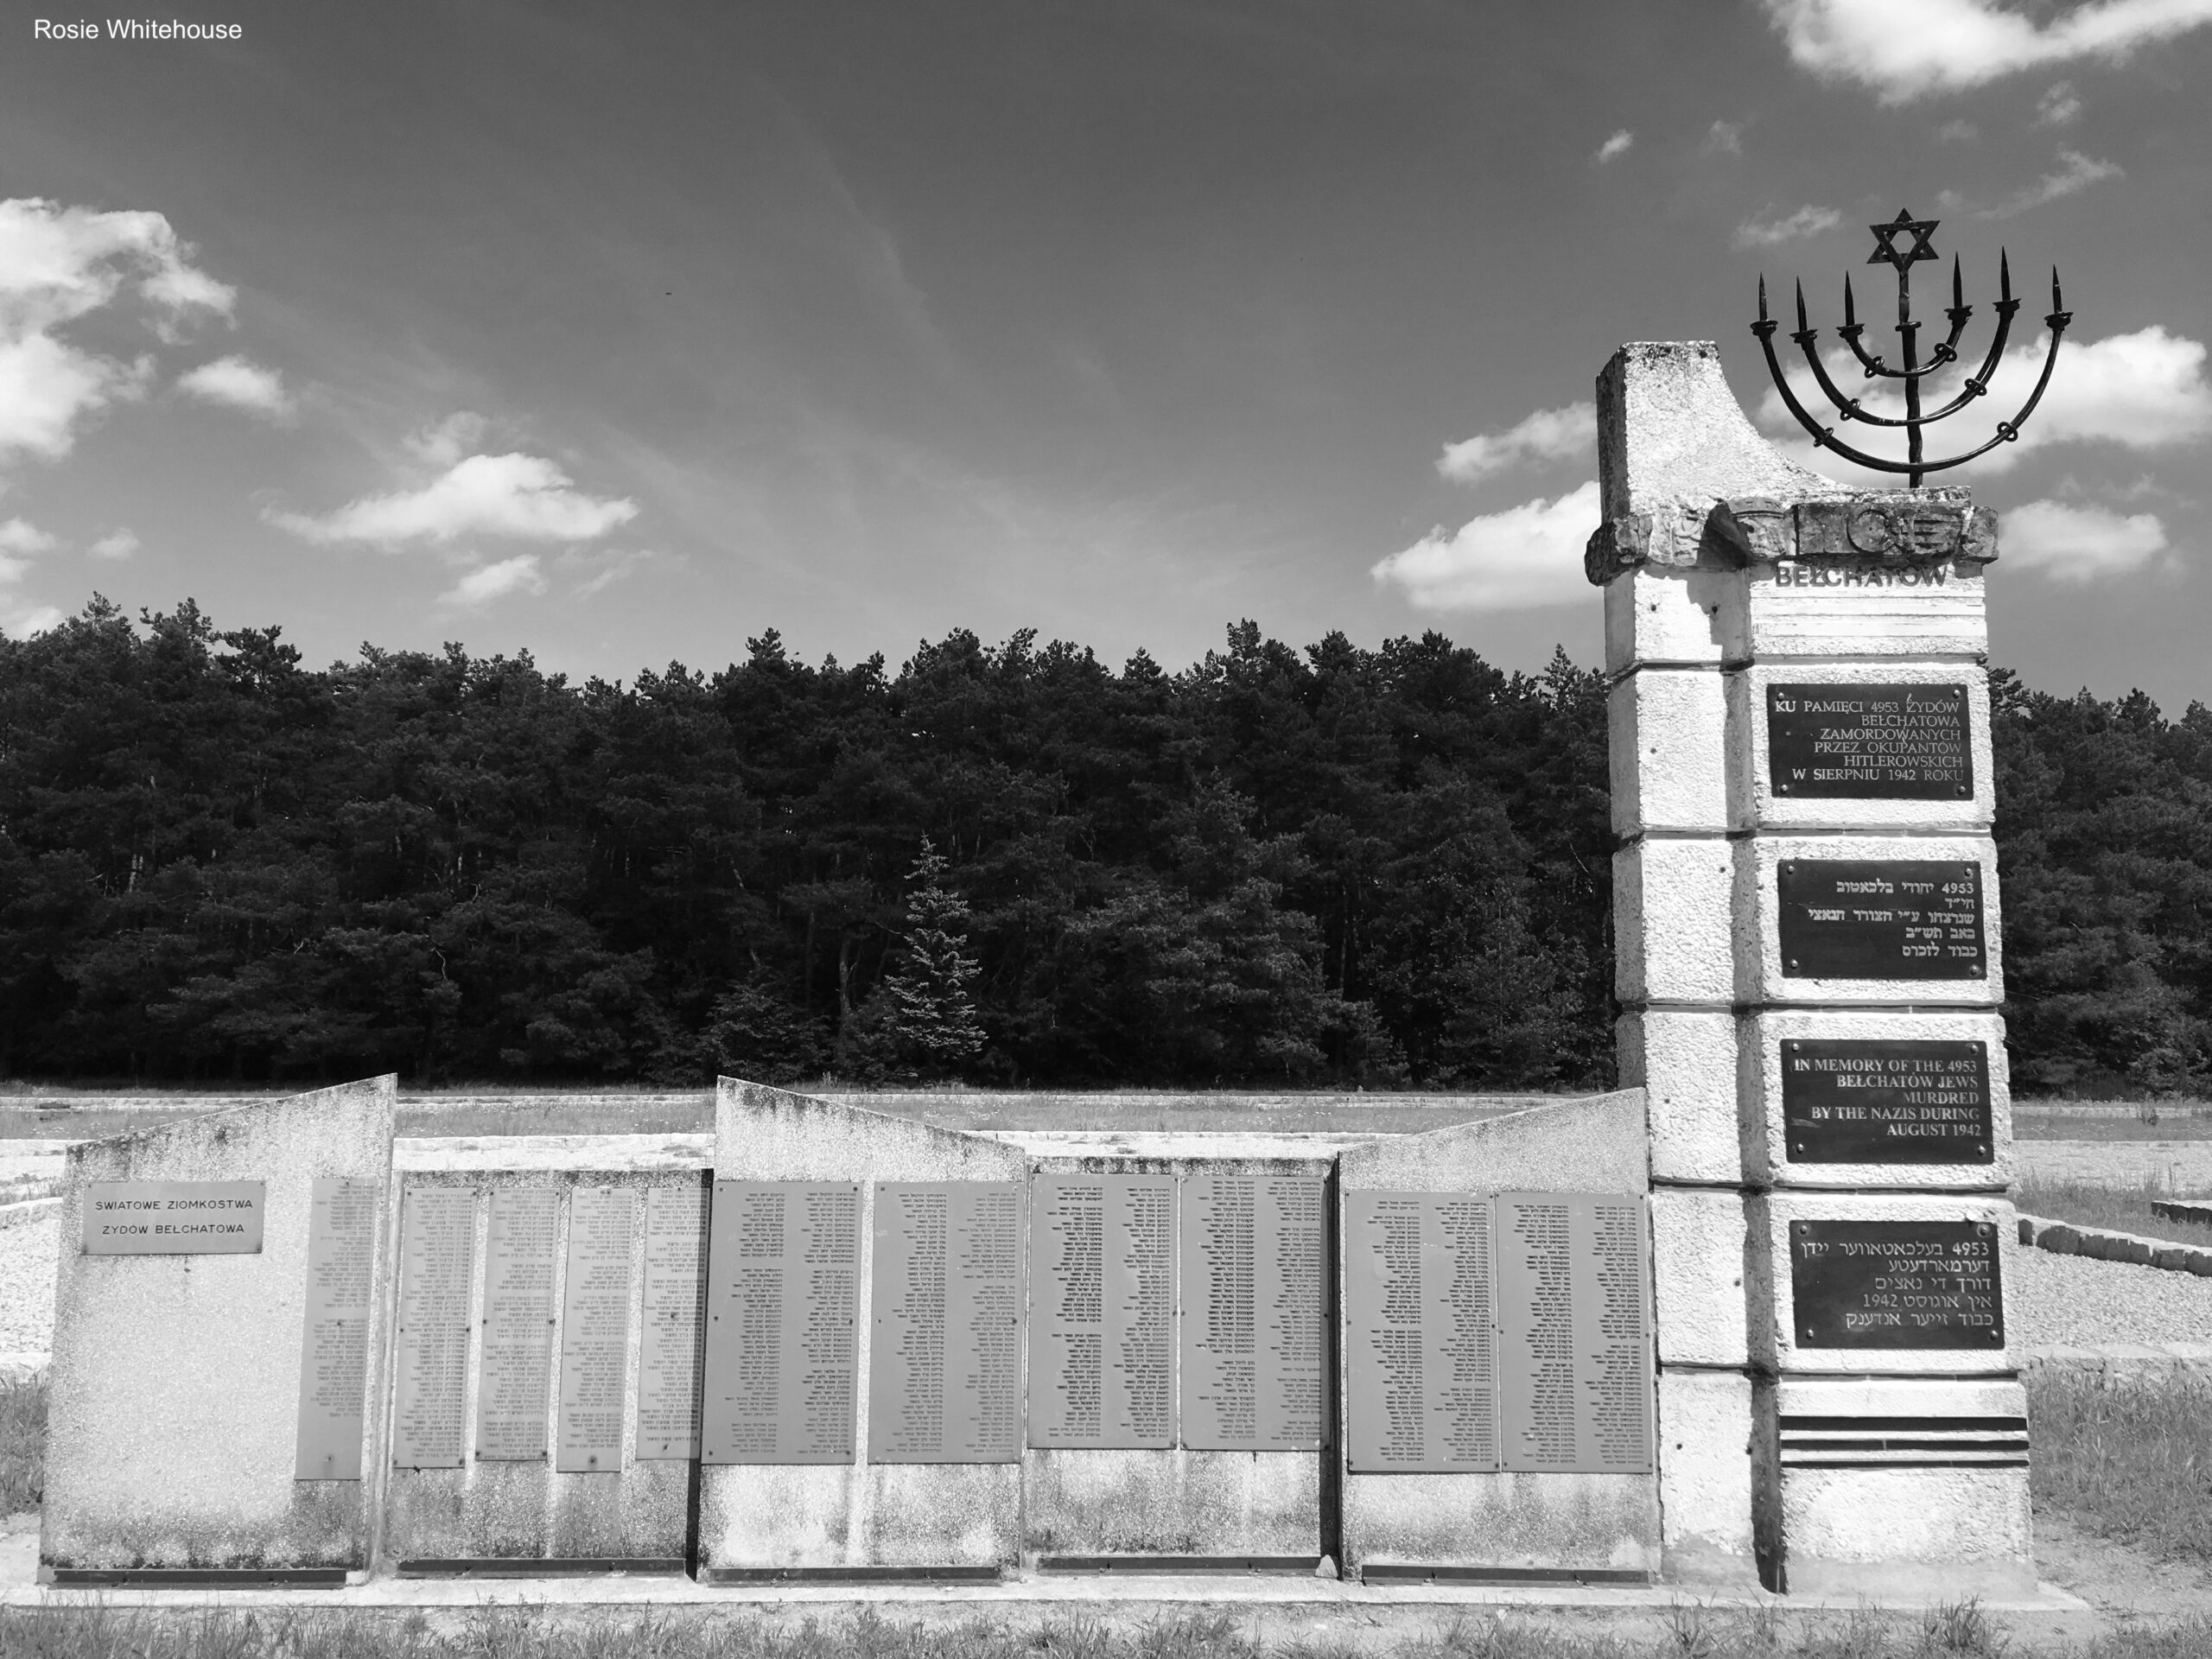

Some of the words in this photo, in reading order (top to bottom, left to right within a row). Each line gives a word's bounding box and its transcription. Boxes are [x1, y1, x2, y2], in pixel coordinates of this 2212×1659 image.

[1775, 701, 1796, 712] KU
[1804, 701, 1864, 714] PAMIĘCI
[1871, 702, 1899, 713] 4953
[1861, 715, 1961, 728] BEŁCHATOWA
[1820, 728, 1961, 741] ZAMORDOWANYCH
[1815, 741, 1860, 753] PRZEZ
[1844, 755, 1963, 767] HITLEROWSKICH
[1792, 768, 1806, 780] W
[1814, 768, 1880, 780] SIERPNIU
[1888, 769, 1916, 781] 1942
[1923, 769, 1964, 781] ROKU
[1902, 882, 1934, 894] יהודי
[1942, 882, 1974, 894] 4953
[1950, 927, 1976, 939] באב
[1794, 1058, 1810, 1071] IN
[1815, 1058, 1885, 1071] MEMORY
[1888, 1059, 1908, 1071] OF
[1913, 1059, 1944, 1071] THE
[1948, 1059, 1977, 1072] 4953
[1937, 1075, 1978, 1089] JEWS
[1904, 1091, 1980, 1104] MURDRED
[1811, 1106, 1832, 1119] BY
[1834, 1106, 1866, 1120] THE
[1871, 1107, 1916, 1120] NAZIS
[1920, 1107, 1980, 1121] DURING
[1886, 1123, 1948, 1136] AUGUST
[1952, 1123, 1981, 1136] 1942
[167, 1199, 253, 1210] ZIOMKOSTWA
[155, 1224, 245, 1235] BEŁCHATOWA
[1952, 1242, 1989, 1256] 4953
[1931, 1278, 1947, 1289] די
[1863, 1294, 1898, 1307] 1942
[1967, 1295, 1993, 1311] אין
[1958, 1313, 1994, 1325] כבוד
